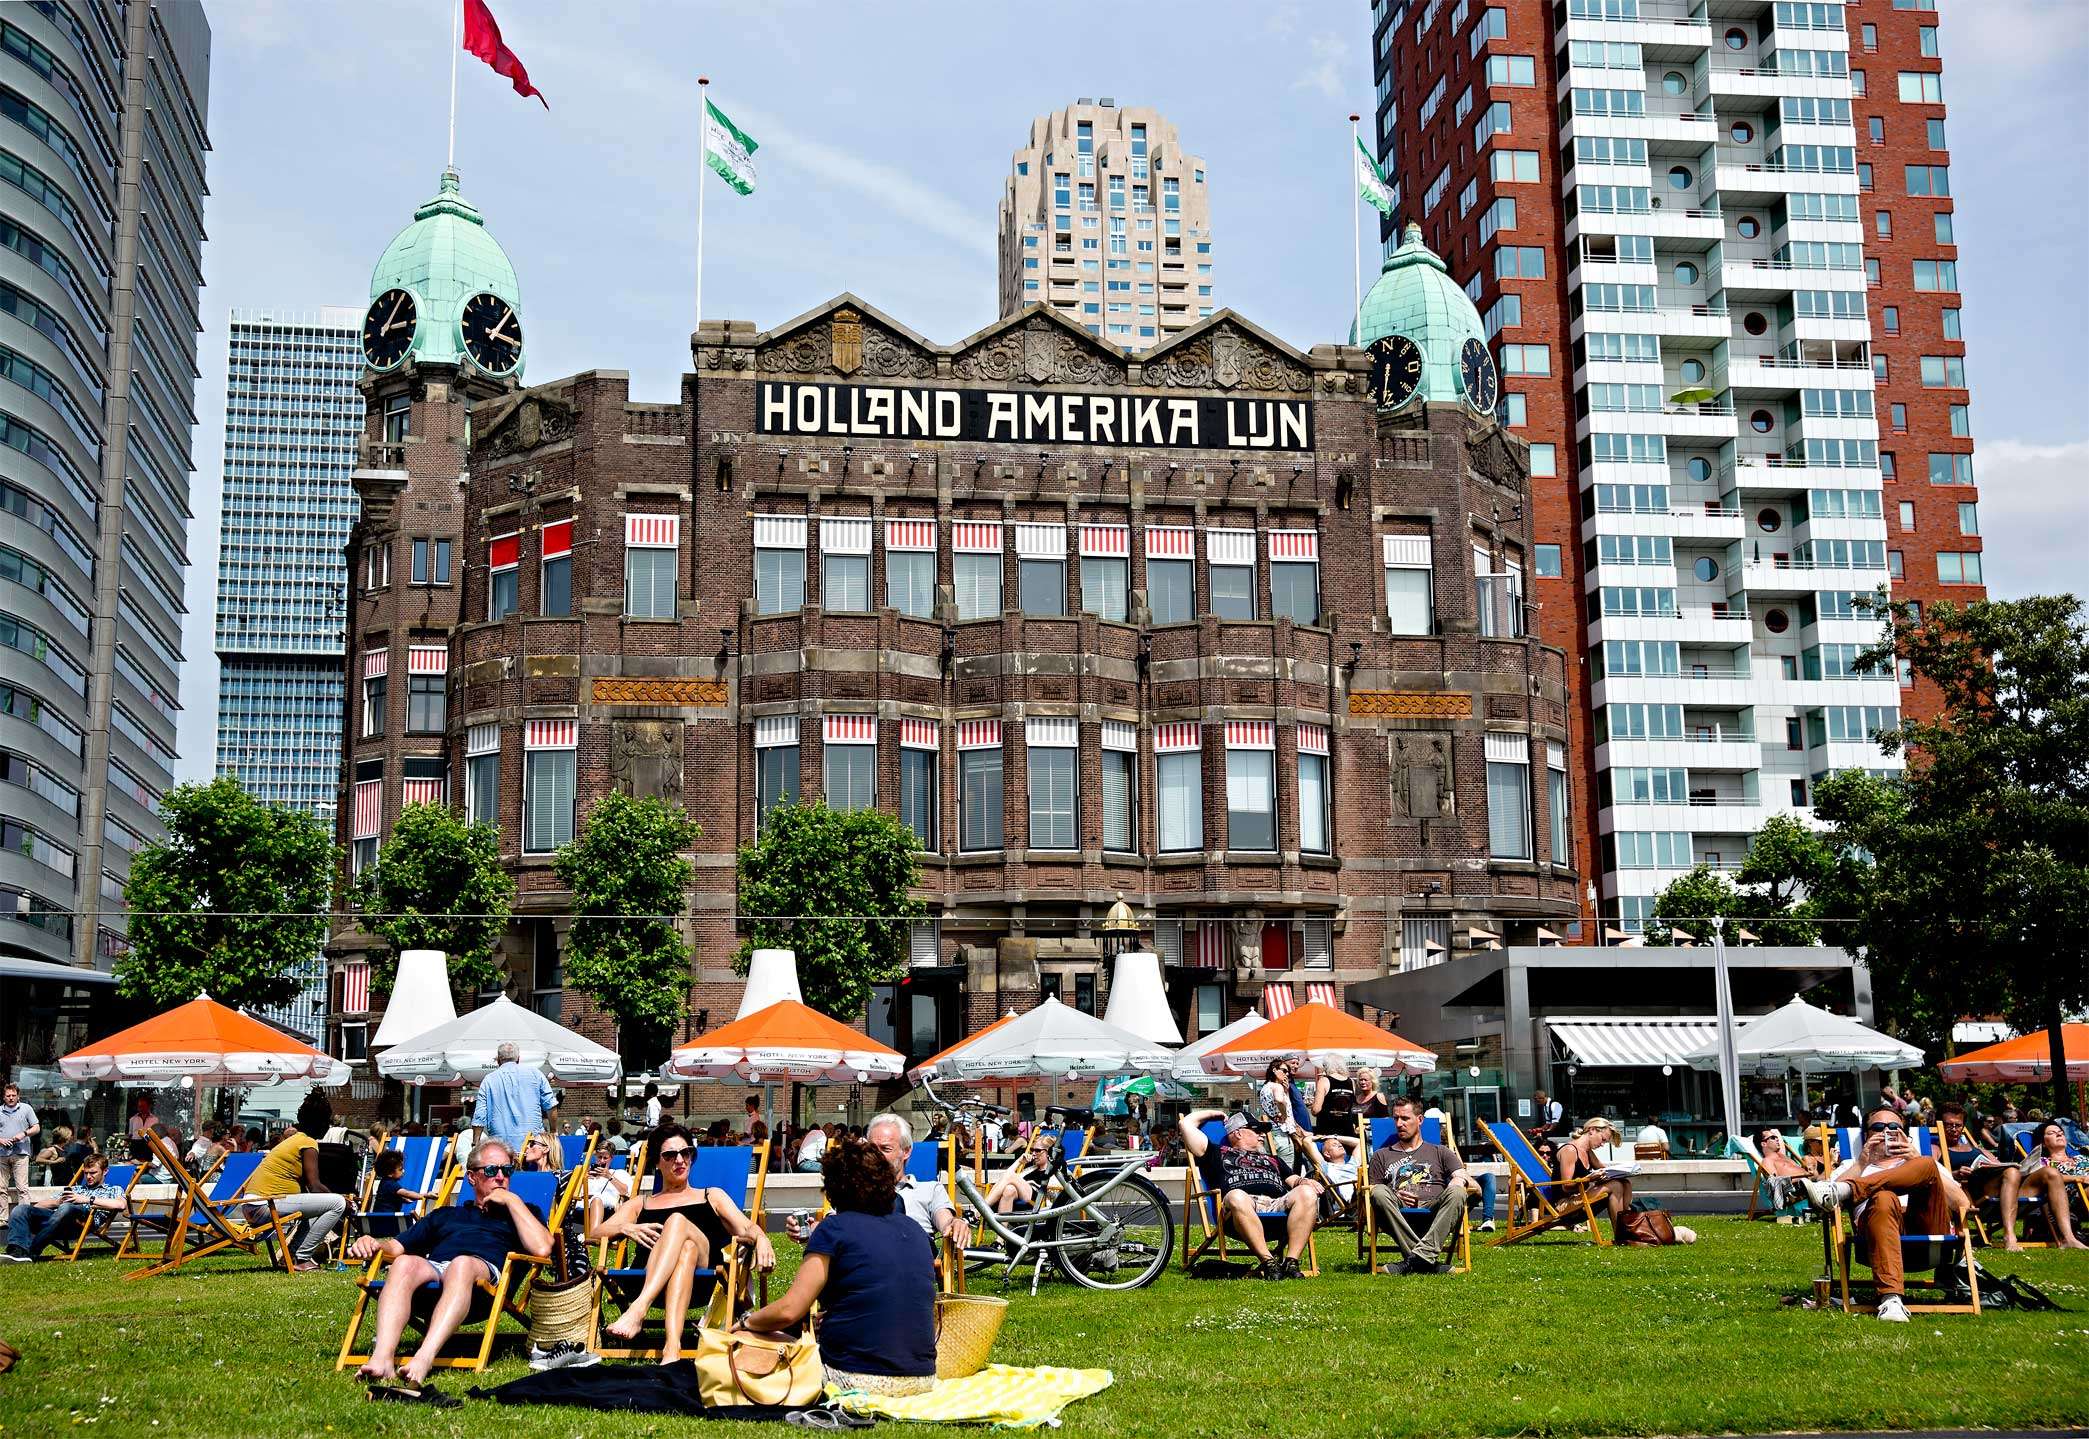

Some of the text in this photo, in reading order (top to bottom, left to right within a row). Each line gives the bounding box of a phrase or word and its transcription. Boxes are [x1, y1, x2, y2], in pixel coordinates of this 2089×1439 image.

[1381, 339, 1394, 352] N
[765, 385, 961, 437] HOLLAND
[987, 393, 1199, 445] AMERIKA
[1228, 1175, 1239, 1184] ON
